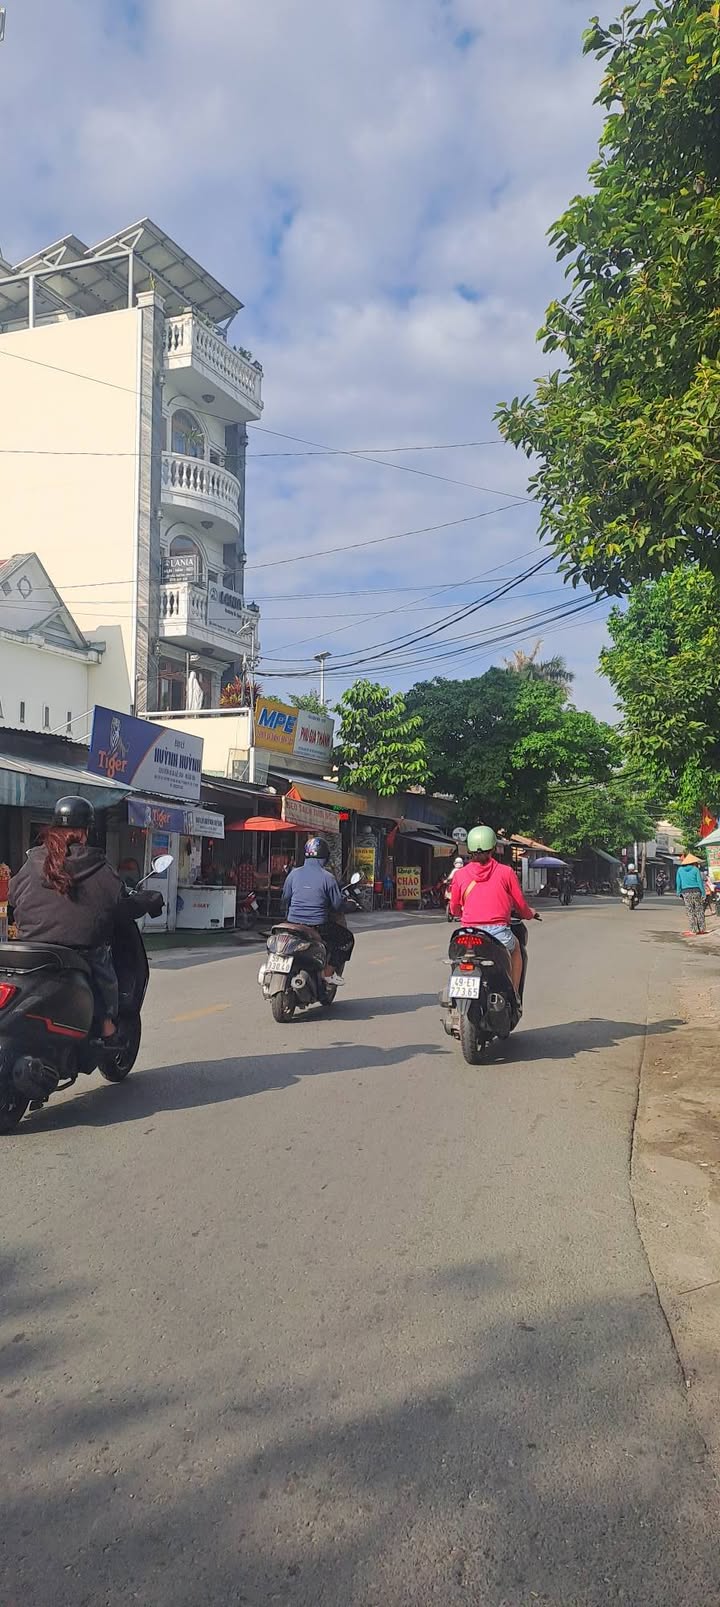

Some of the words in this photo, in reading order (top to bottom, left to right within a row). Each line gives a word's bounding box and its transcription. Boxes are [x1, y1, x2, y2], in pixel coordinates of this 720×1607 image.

[258, 707, 297, 734] MPE
[98, 750, 128, 778] Tiger
[152, 807, 171, 828] Tiger
[450, 987, 479, 997] 773.65
[454, 978, 476, 988] 49-E1
